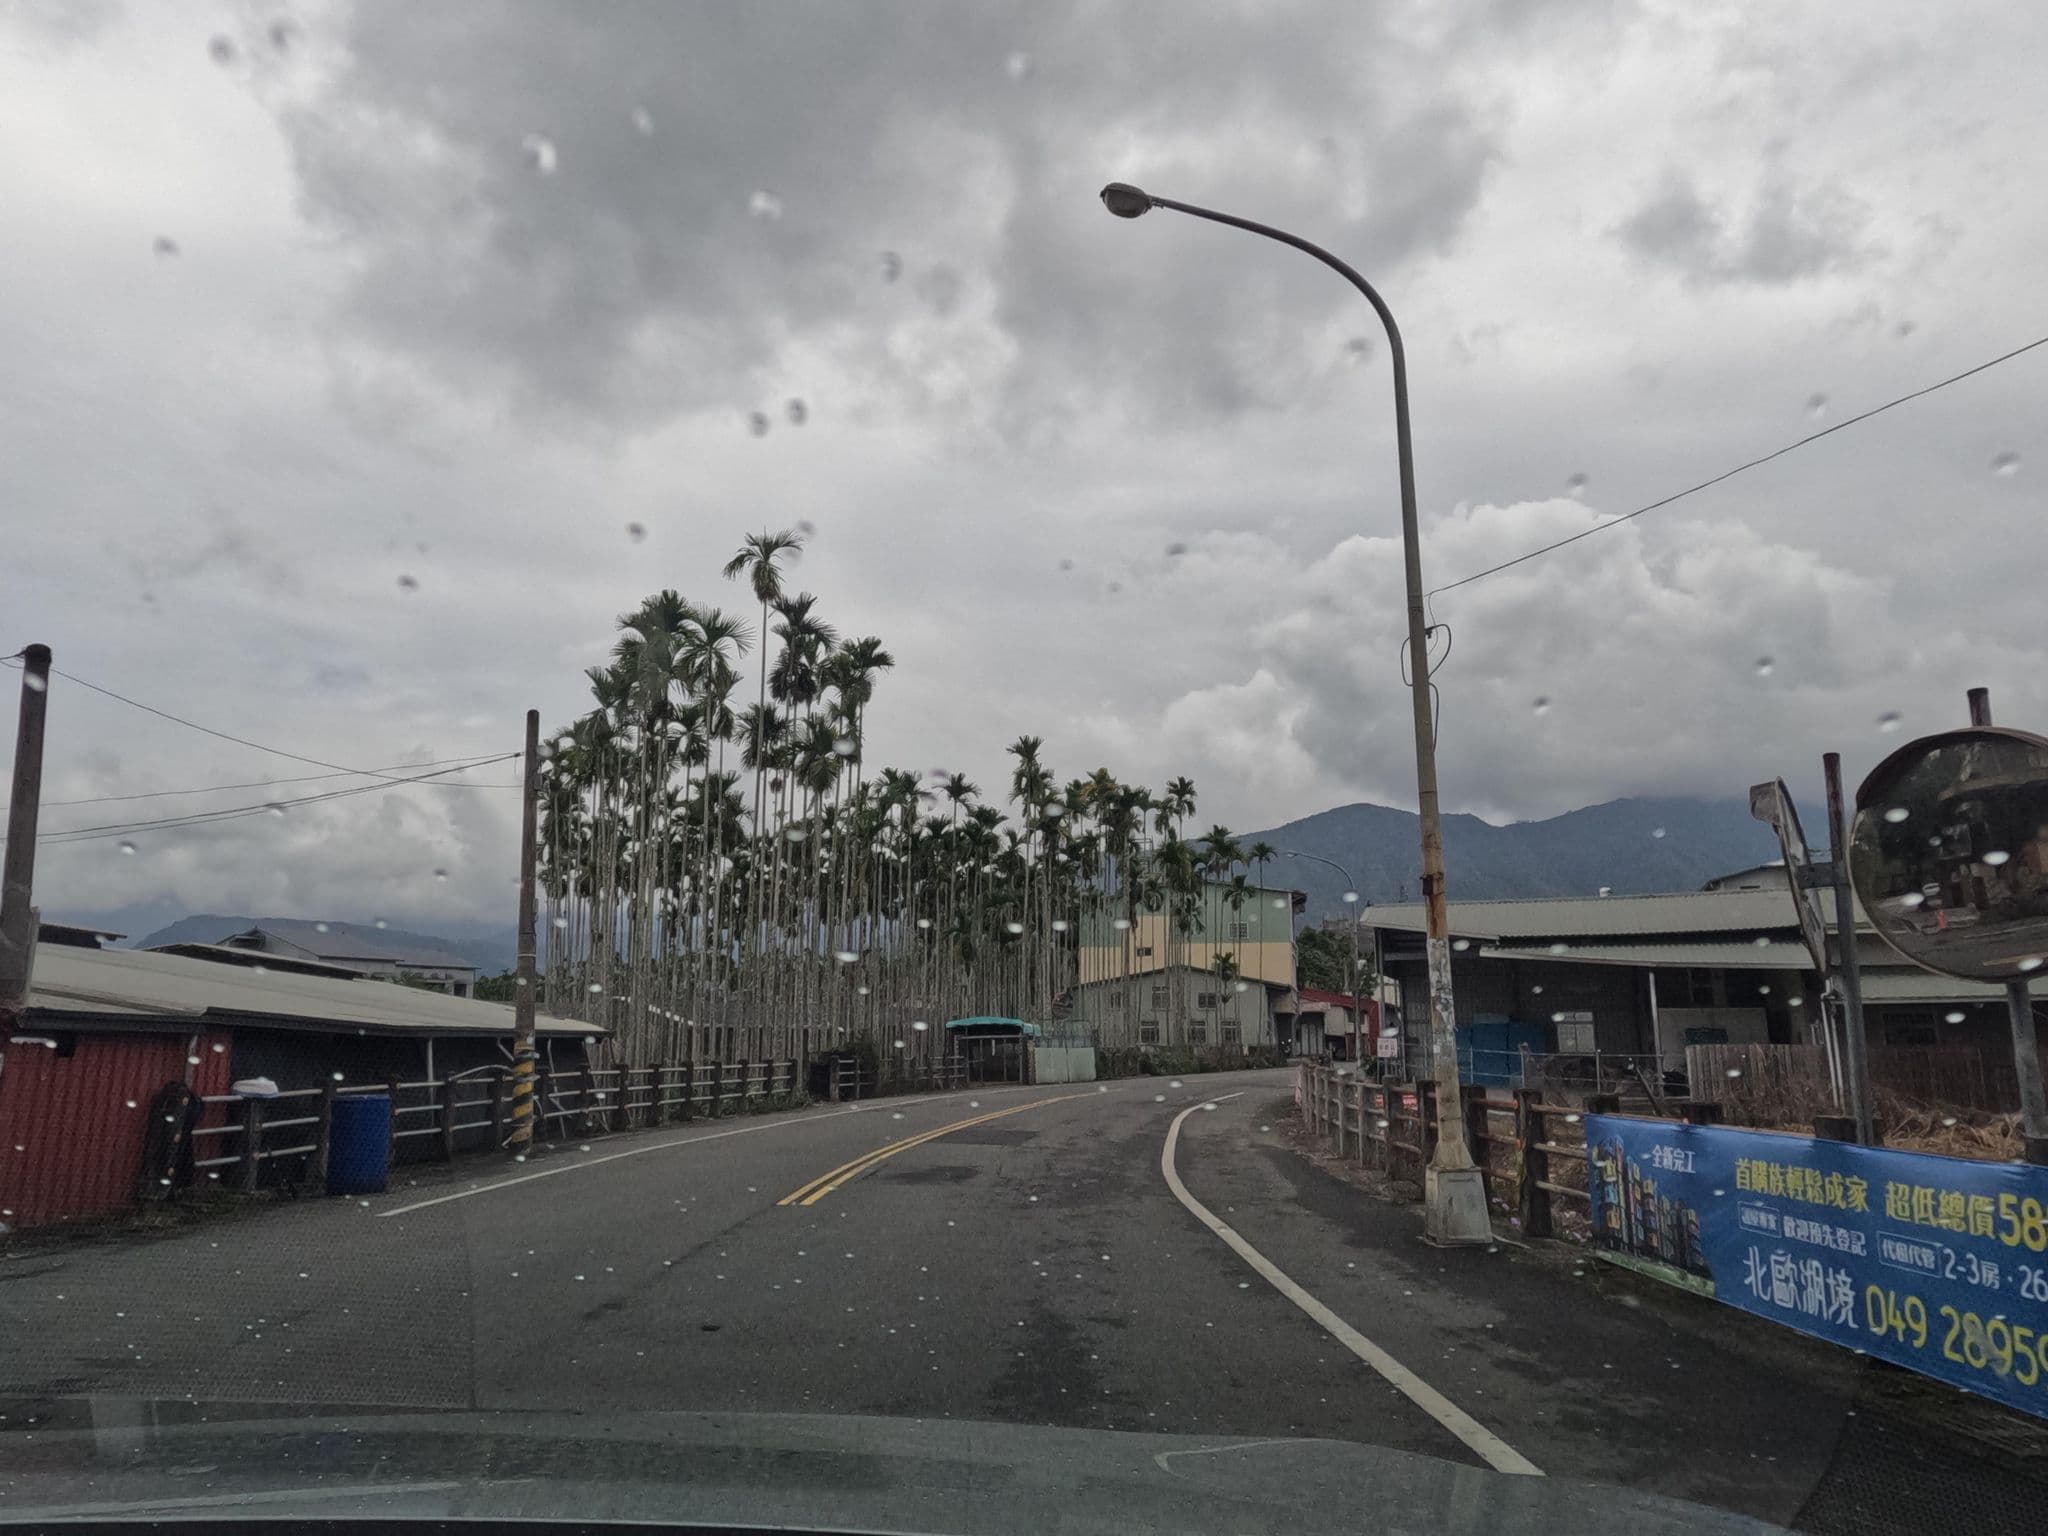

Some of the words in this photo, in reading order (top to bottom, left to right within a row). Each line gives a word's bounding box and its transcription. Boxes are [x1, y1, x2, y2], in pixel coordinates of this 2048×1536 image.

[1652, 1144, 1696, 1173] 全新完工
[1736, 1158, 1869, 1212] 首購族輕鬆成家
[1783, 1215, 1867, 1256] 歡迎預先登記
[1744, 1246, 1859, 1328] 北歐湖境
[1866, 1284, 1927, 1348] 049
